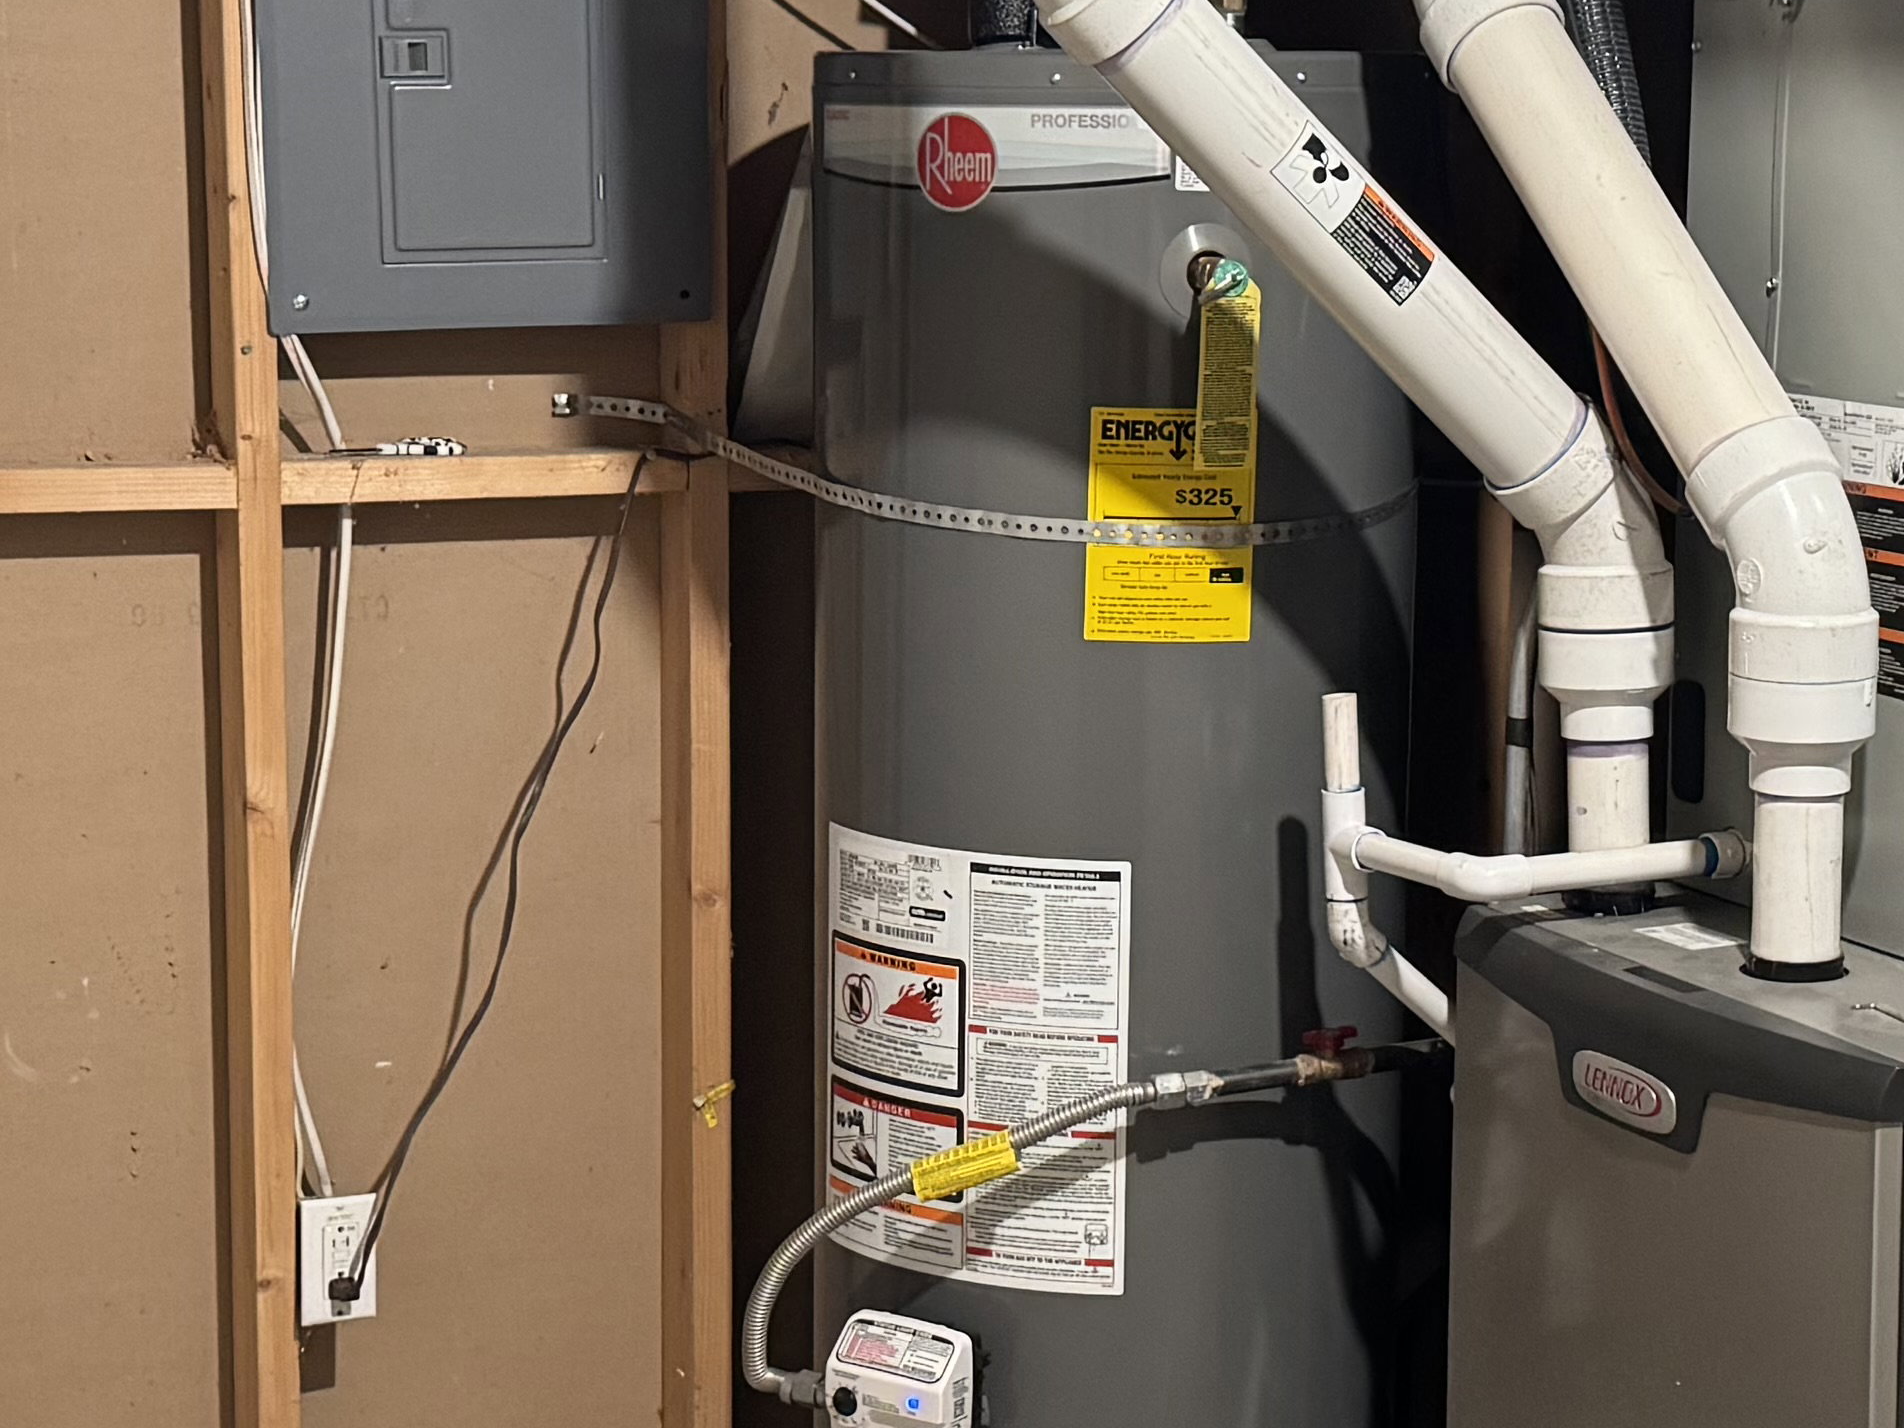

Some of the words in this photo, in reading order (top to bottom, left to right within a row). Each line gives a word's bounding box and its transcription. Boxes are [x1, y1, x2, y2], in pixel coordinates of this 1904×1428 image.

[1031, 113, 1130, 130] PROFESSIO
[925, 116, 993, 195] Rheem
[1101, 419, 1196, 449] ENERGYG
[1175, 488, 1233, 506] $325
[869, 953, 917, 972] WARNING
[1584, 1063, 1645, 1110] LENNOX
[872, 1102, 912, 1117] DANGER
